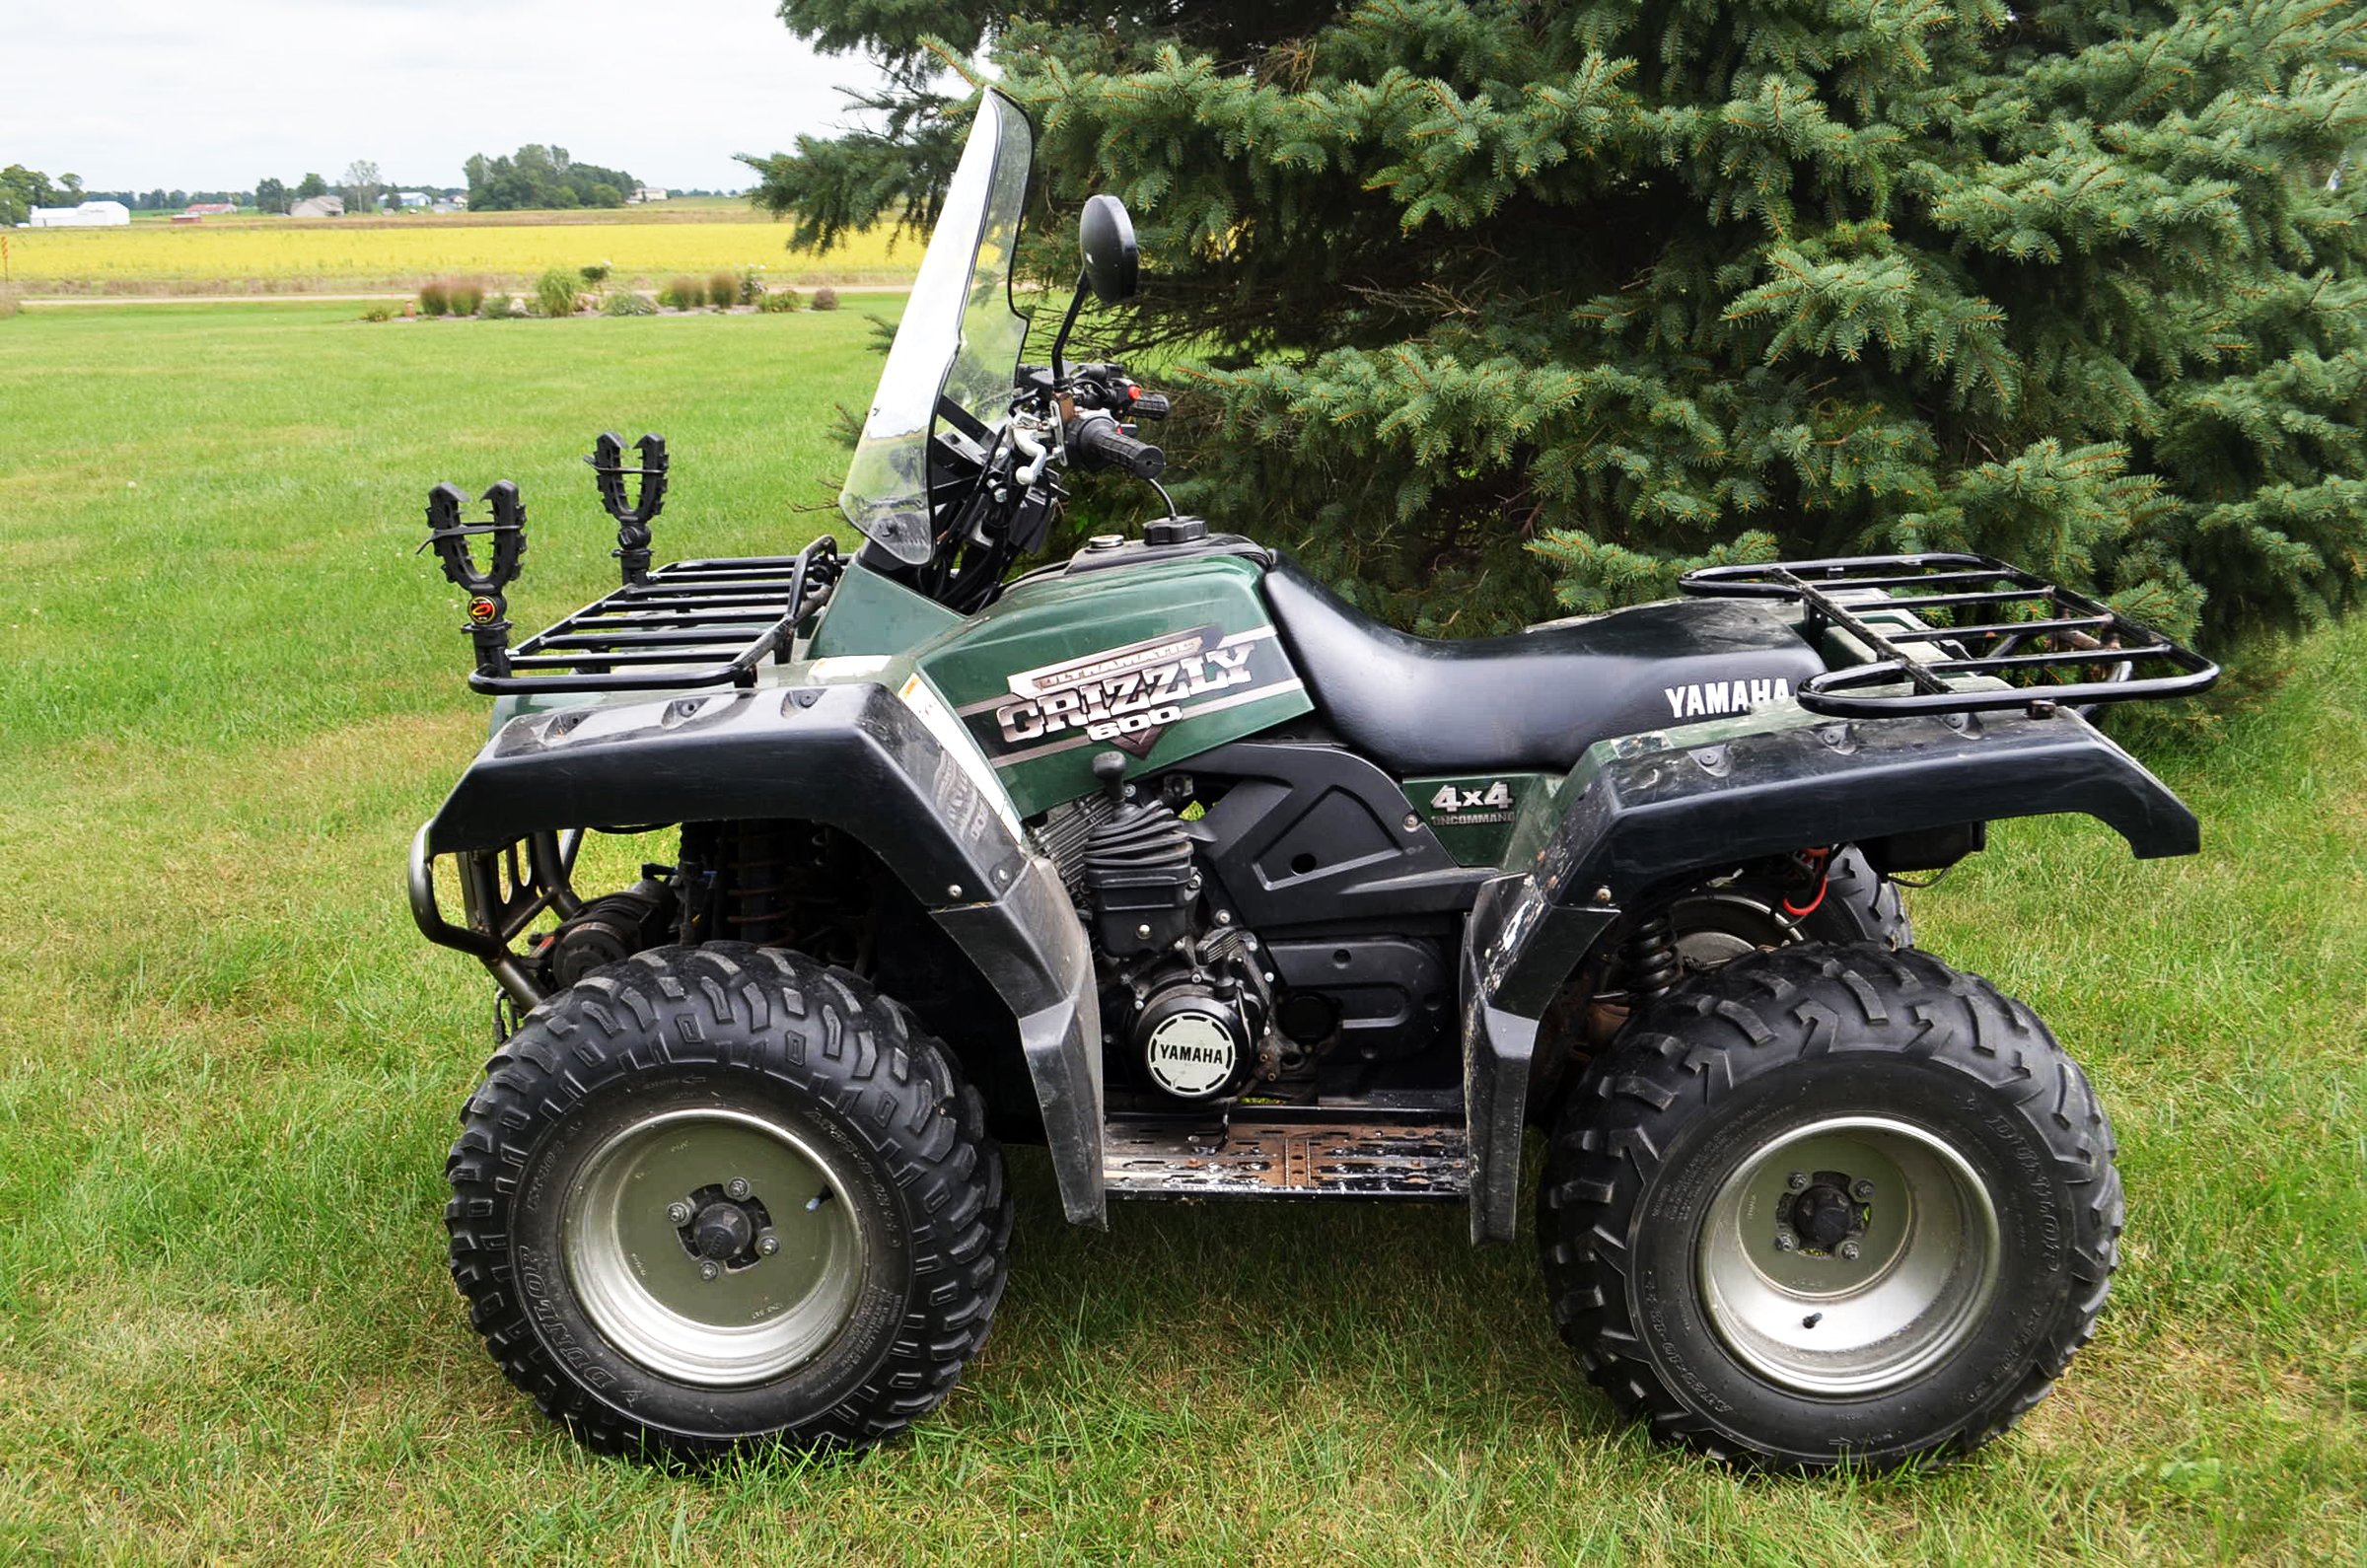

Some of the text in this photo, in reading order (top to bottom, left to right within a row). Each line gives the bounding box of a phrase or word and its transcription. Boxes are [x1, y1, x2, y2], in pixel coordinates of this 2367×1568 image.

[1039, 639, 1200, 688] ULTRAMATIC
[996, 641, 1255, 743] GRIZZLY
[1665, 677, 1790, 719] YAMAHA
[1087, 703, 1184, 742] 600
[1431, 781, 1513, 813] 4x4
[1432, 811, 1517, 826] ONCOMMAND
[1160, 1043, 1223, 1065] YAMAHA
[518, 1245, 618, 1390] DUNLOP
